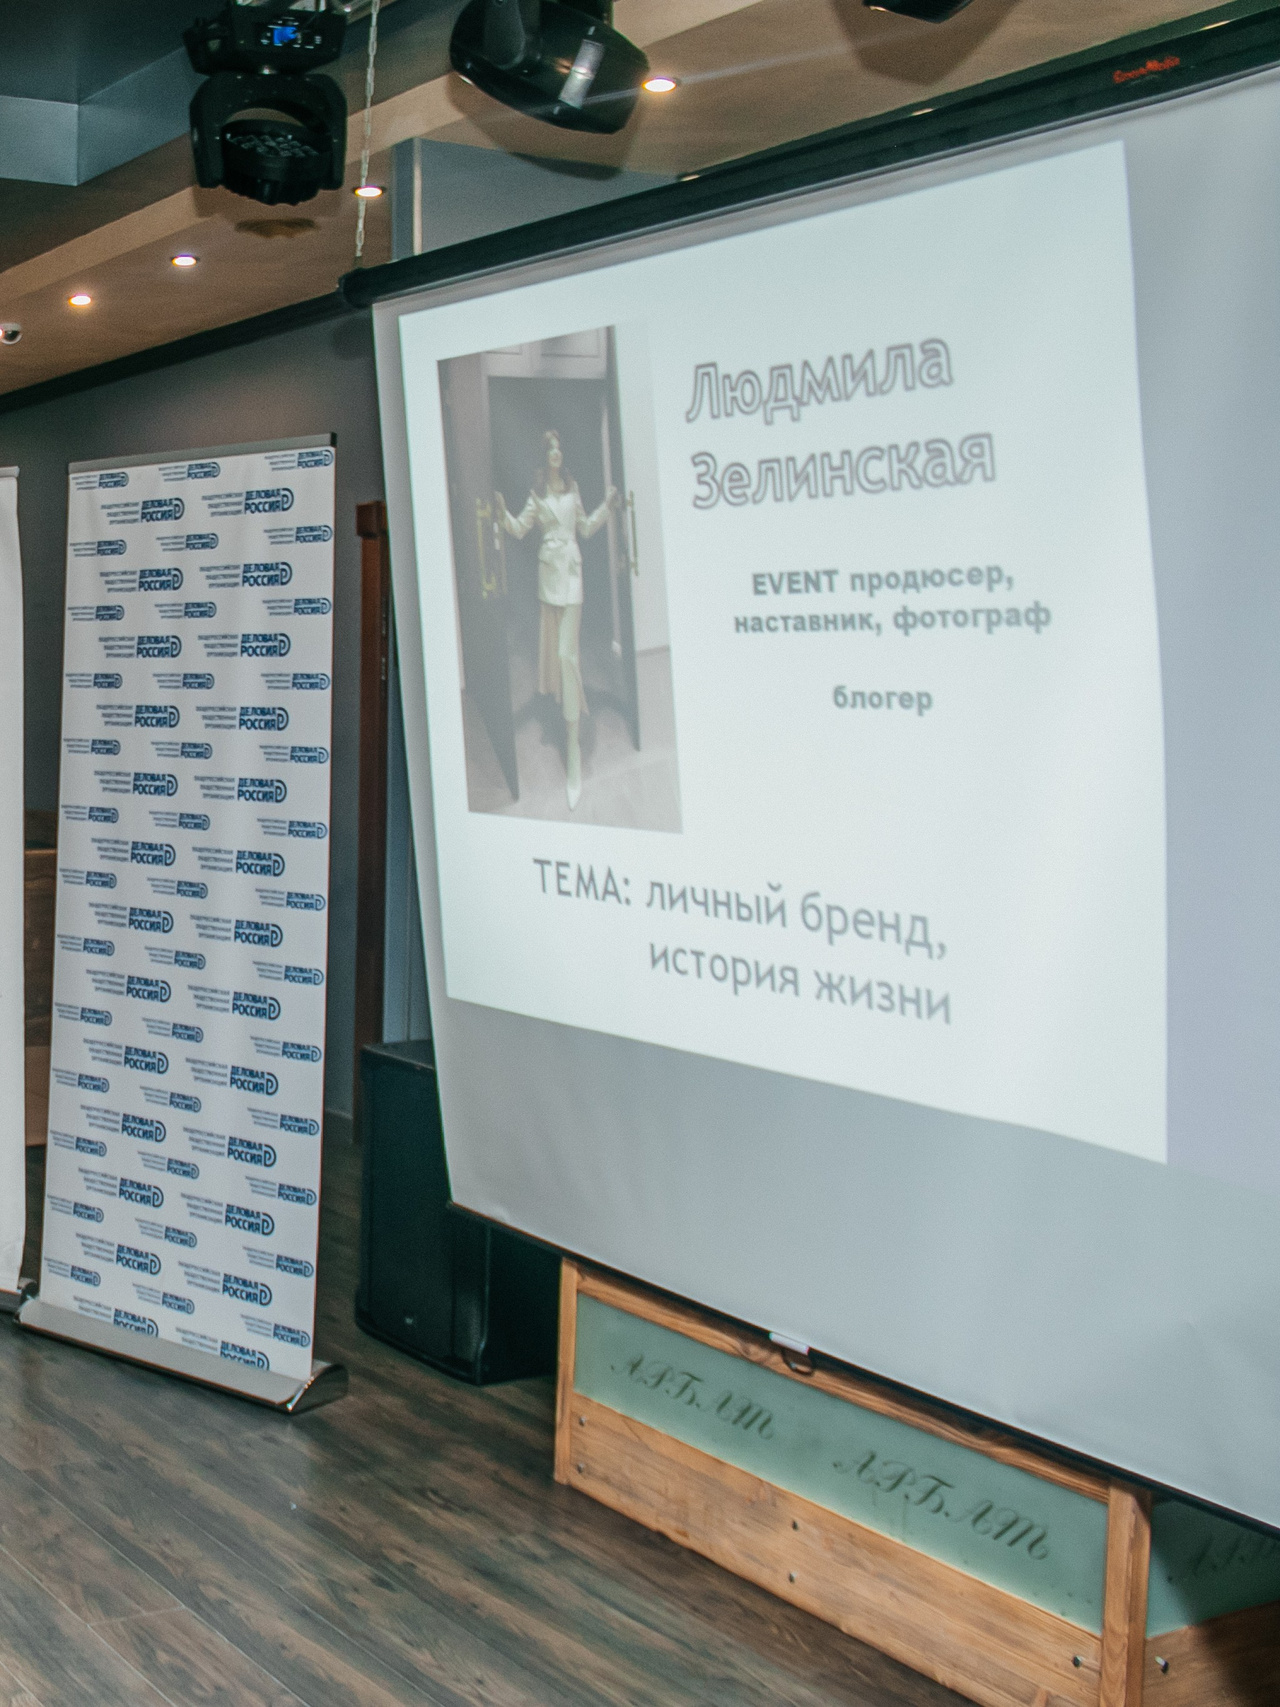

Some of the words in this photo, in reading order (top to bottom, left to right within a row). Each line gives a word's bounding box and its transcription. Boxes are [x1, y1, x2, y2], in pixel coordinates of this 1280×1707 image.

[685, 338, 954, 426] Людмила
[691, 432, 997, 510] Зелинская
[245, 499, 280, 513] РОССИЯ
[243, 573, 278, 586] РОССИЯ
[752, 569, 839, 595] EVENT
[850, 564, 1015, 597] продюсер,
[734, 609, 883, 638] наставник,
[892, 601, 1052, 636] фотограф
[241, 644, 277, 656] РОССИЯ
[832, 685, 934, 716] блогер
[240, 717, 275, 729] РОССИЯ
[238, 788, 273, 801] РОССИЯ
[236, 861, 271, 875] РОССИЯ
[532, 858, 632, 906] ТЕМА:
[646, 881, 788, 928] личный
[800, 891, 948, 961] бренд,
[234, 930, 269, 945] РОССИЯ
[648, 941, 800, 996] история
[813, 969, 953, 1025] жизни
[232, 1002, 267, 1018] РОССИЯ
[229, 1076, 265, 1093] РОССИЯ
[227, 1147, 262, 1165] РОССИЯ
[224, 1214, 260, 1234] РОССИЯ
[222, 1283, 258, 1304] РОССИЯ
